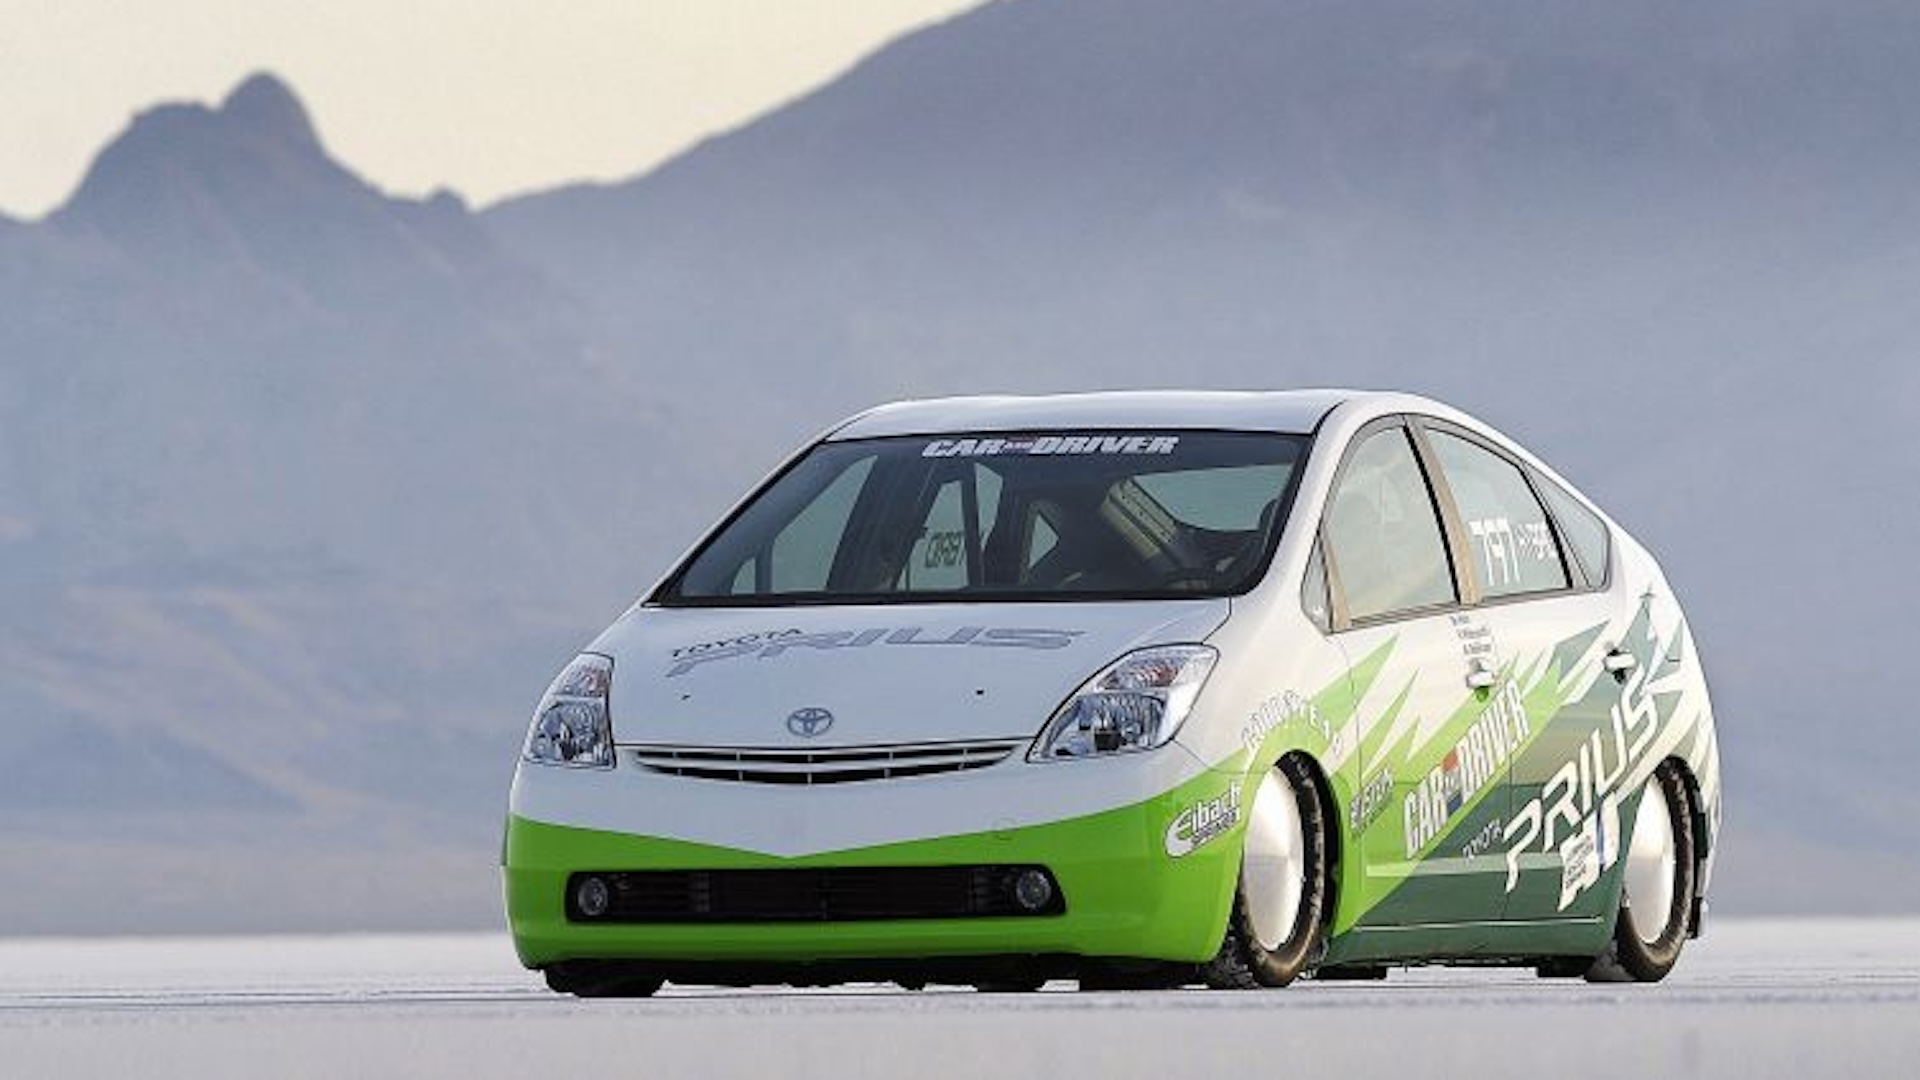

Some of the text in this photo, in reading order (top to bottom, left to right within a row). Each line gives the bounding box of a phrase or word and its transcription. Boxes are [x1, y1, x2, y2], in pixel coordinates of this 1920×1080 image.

[922, 438, 1005, 457] CAR
[1029, 436, 1179, 454] DRIVER
[665, 627, 1088, 677] PRIUS
[672, 628, 802, 657] TOYOTA
[1403, 764, 1447, 859] CAR
[1456, 676, 1530, 804] DRIVER
[1502, 663, 1658, 894] PRIUS
